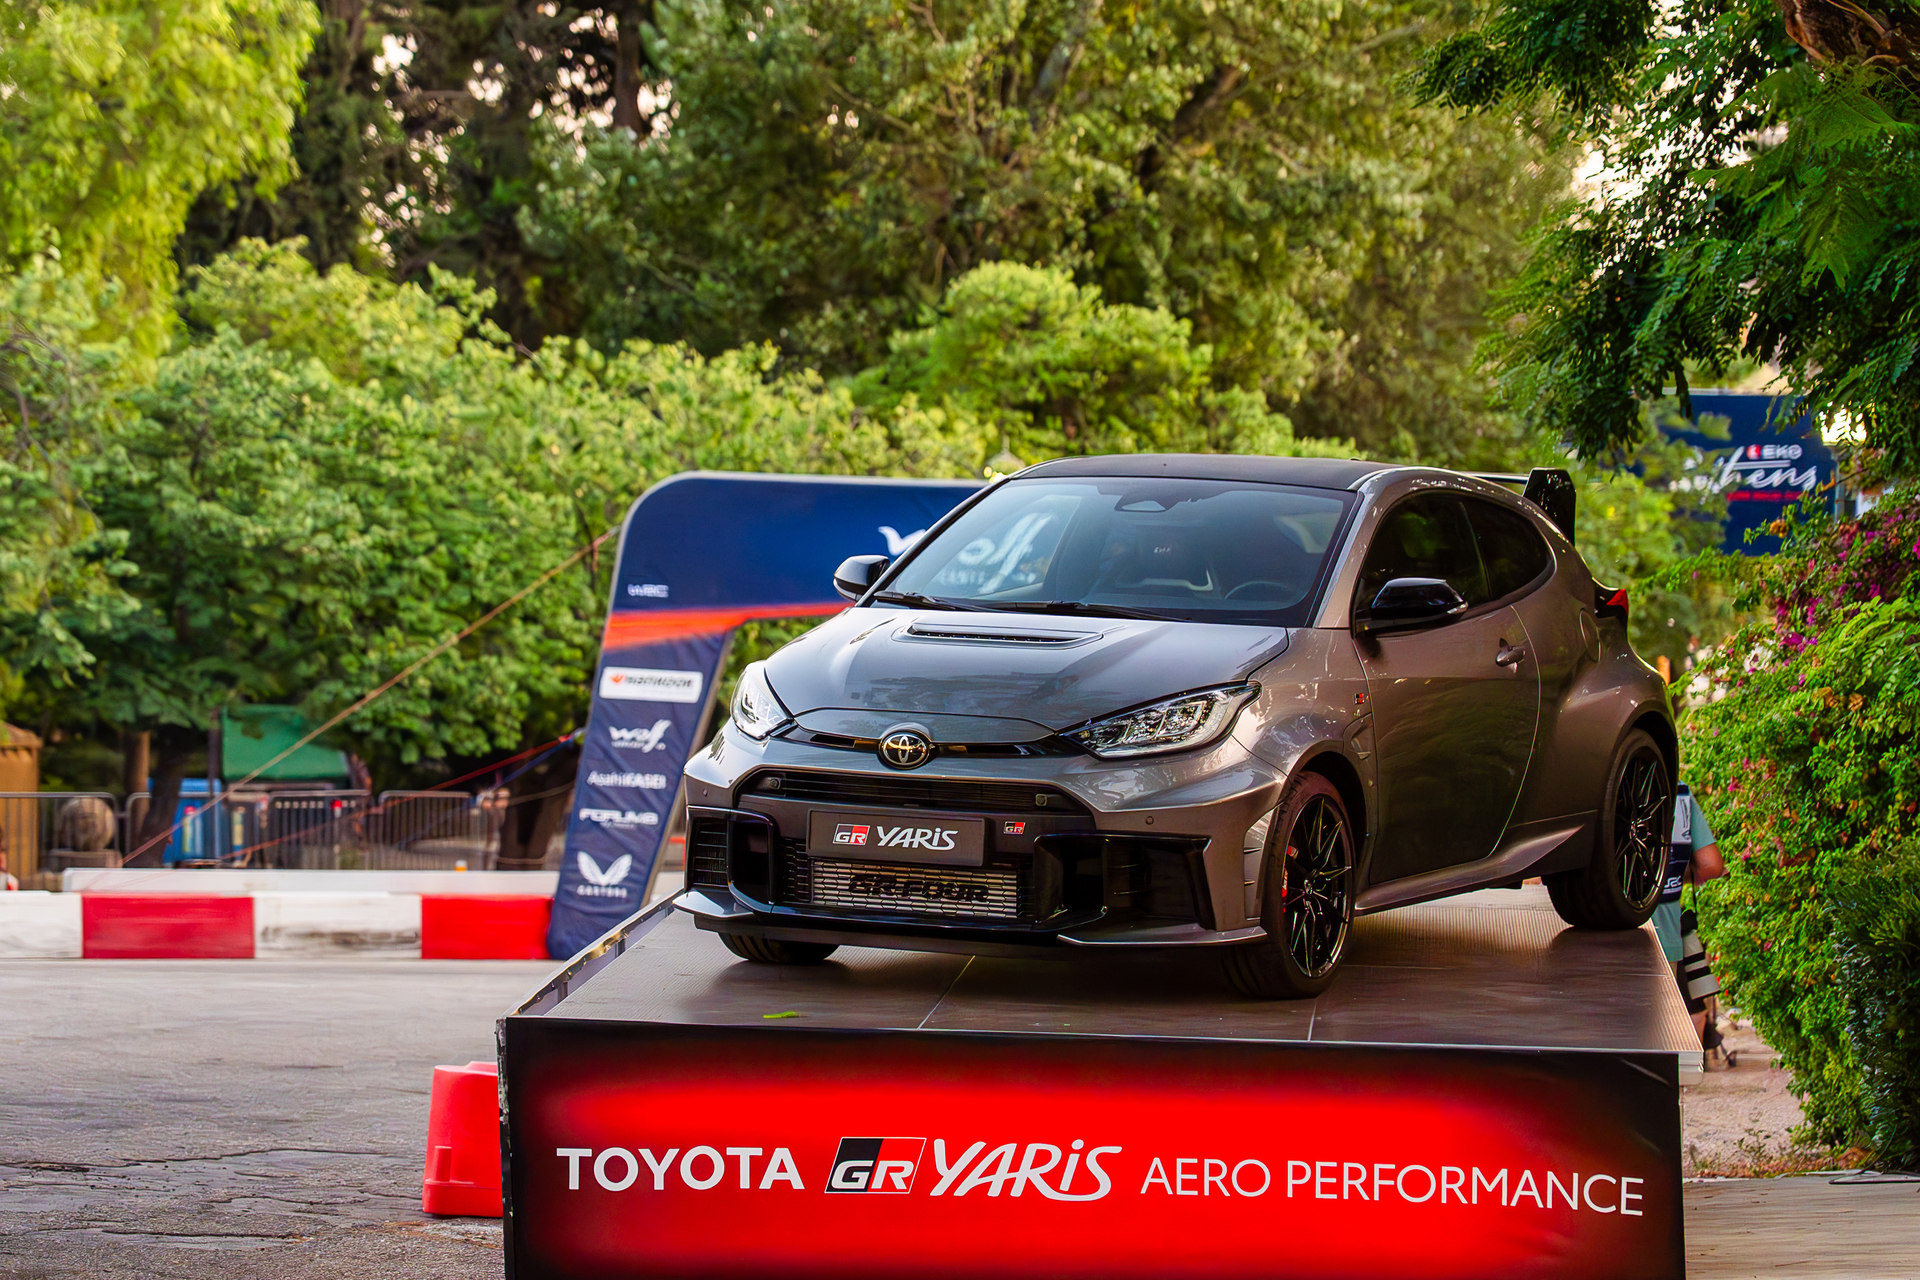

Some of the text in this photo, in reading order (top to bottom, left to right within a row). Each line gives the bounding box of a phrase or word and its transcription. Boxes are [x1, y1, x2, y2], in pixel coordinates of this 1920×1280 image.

[1004, 824, 1025, 834] GR
[834, 831, 868, 845] GR
[556, 1144, 806, 1192] TOYOTA
[829, 1158, 920, 1192] GR
[1139, 1156, 1272, 1199] AERO
[1286, 1159, 1644, 1217] PERFORMANCE
